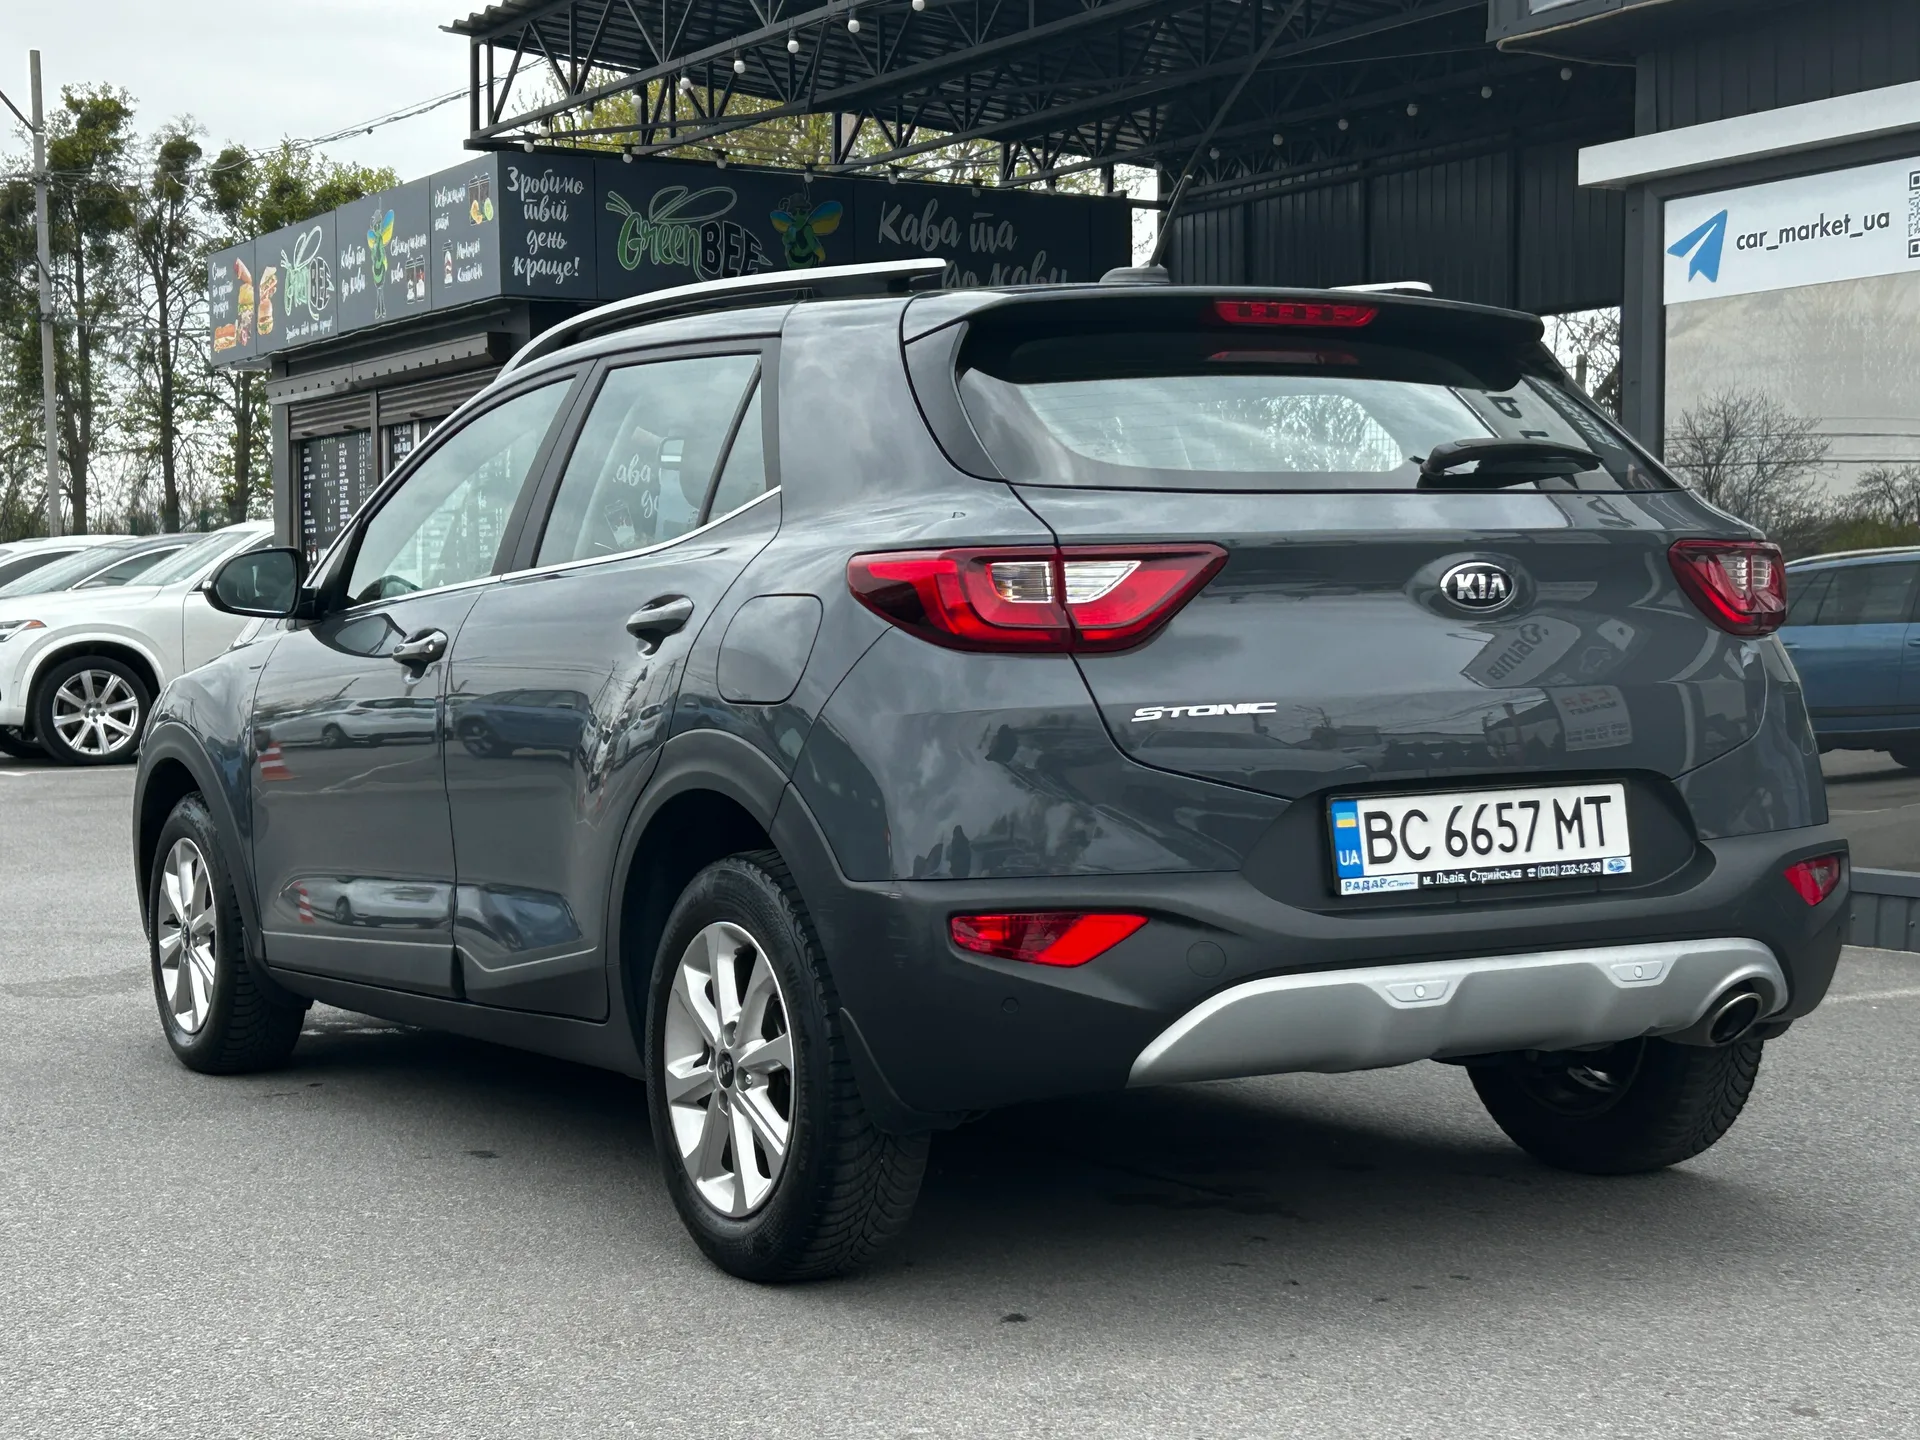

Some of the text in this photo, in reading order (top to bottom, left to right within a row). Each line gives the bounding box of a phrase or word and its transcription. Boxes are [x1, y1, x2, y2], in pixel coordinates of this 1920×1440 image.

[507, 166, 584, 201] Зробимо
[524, 195, 569, 222] твій
[878, 198, 1018, 253] Кава та
[1736, 211, 1890, 251] car_market_ua
[527, 229, 567, 255] день
[512, 256, 580, 286] краще!
[612, 453, 651, 487] ава
[1455, 573, 1506, 599] KIA
[1131, 702, 1277, 723] STONIC
[1364, 795, 1611, 865] BC 6657 MT
[1339, 850, 1360, 866] UA
